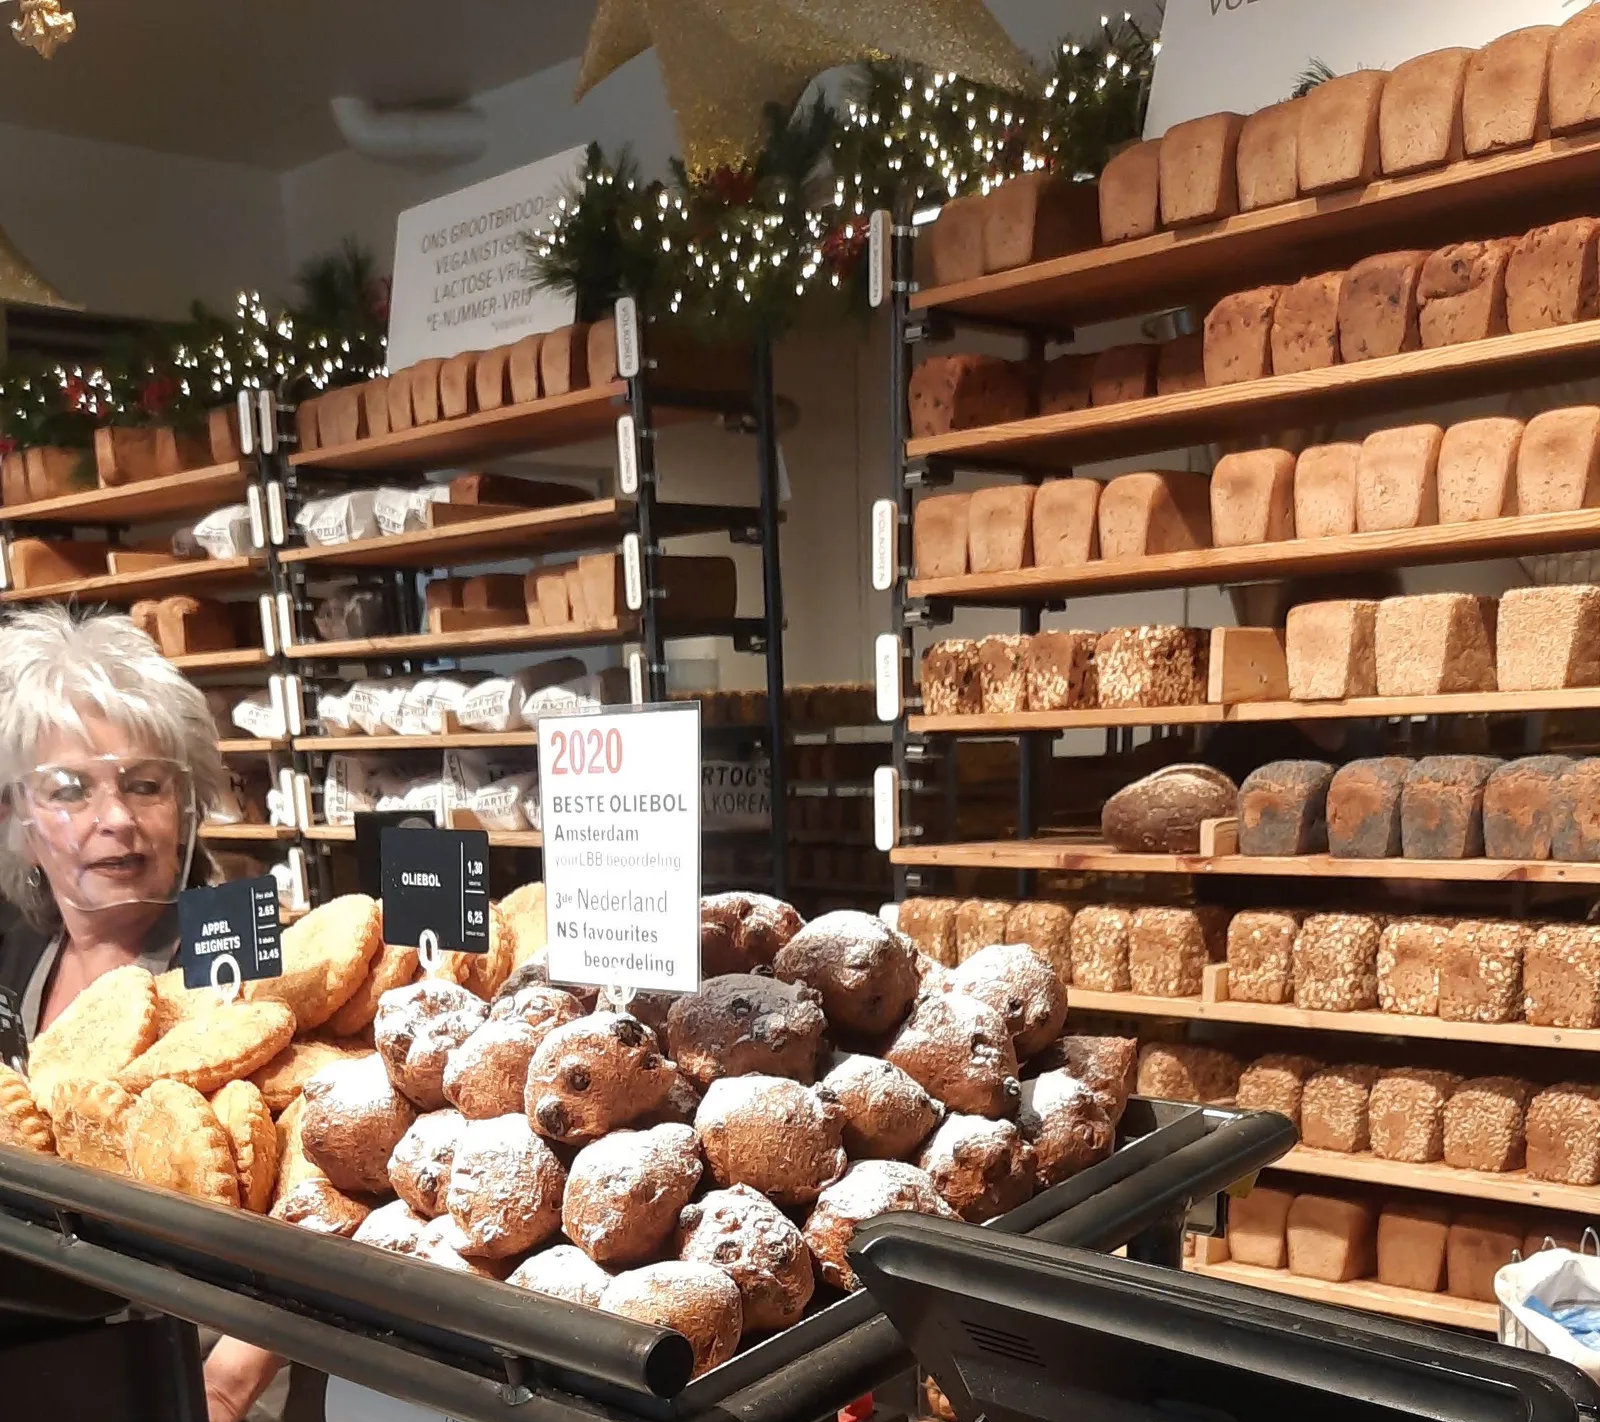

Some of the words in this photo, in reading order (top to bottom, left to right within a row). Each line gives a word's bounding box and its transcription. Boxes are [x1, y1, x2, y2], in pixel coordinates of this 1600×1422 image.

[421, 229, 448, 255] ONS
[435, 233, 526, 276] VEGANISTISC
[550, 727, 624, 776] 2020
[552, 795, 605, 814] BESTE
[609, 793, 688, 813] OLIEBOL
[554, 824, 640, 842] Amsterdam
[467, 861, 483, 876] 1,30
[606, 852, 681, 872] beoordeling
[401, 872, 441, 887] OLIEBOL
[555, 891, 573, 909] 3de
[577, 887, 668, 913] Nederland
[201, 920, 231, 937] APPEL
[556, 921, 579, 939] NS
[583, 922, 659, 943] favourites
[194, 936, 241, 955] BEIGNETS
